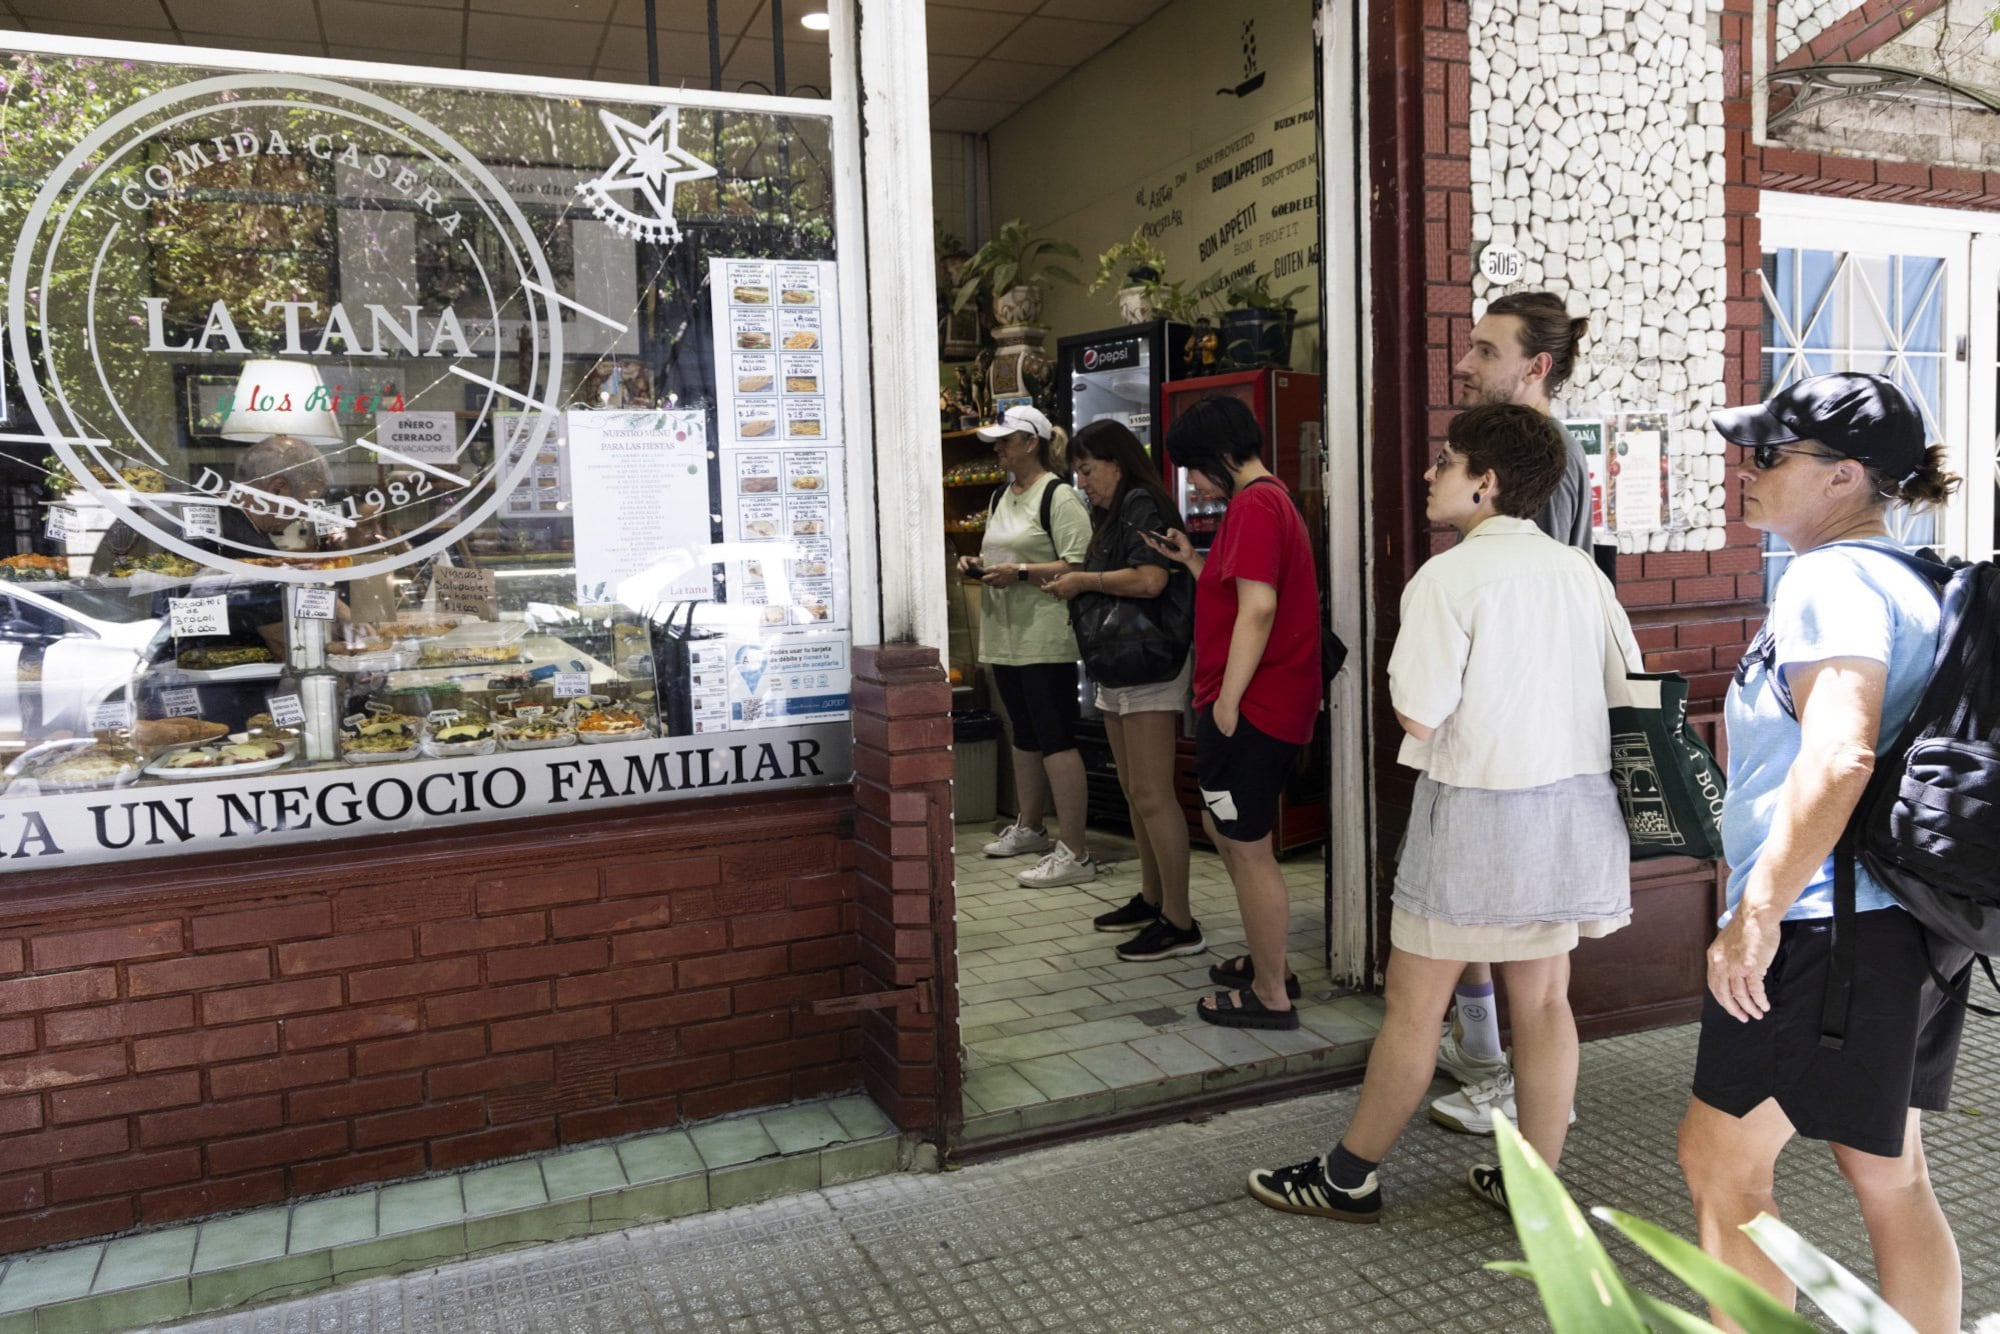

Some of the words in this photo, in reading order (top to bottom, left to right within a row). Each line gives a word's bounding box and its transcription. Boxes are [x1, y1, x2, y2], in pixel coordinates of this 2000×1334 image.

[1274, 115, 1296, 131] BUEN
[1196, 154, 1214, 173] BOM
[1214, 131, 1255, 163] PROVEITO
[121, 130, 290, 211] COMIDA
[308, 133, 463, 237] CASERA
[1212, 167, 1233, 193] BUON
[1235, 148, 1273, 182] APPETITO
[1262, 168, 1284, 187] ENJOY
[1285, 157, 1306, 175] YOUR
[1199, 232, 1219, 263] BON
[1259, 221, 1299, 247] PROFIT
[1273, 249, 1304, 279] GUTEN
[1488, 251, 1518, 277] 5015
[140, 297, 252, 354] LA
[264, 301, 478, 357] TANA
[1099, 347, 1128, 365] pepsi
[245, 384, 293, 412] los
[304, 384, 406, 413] Ricci's
[391, 433, 442, 442] CERRADO
[398, 420, 434, 429] ENERO
[602, 430, 643, 438] NUESTRO
[401, 445, 451, 453] VACACIONES
[601, 443, 624, 451] PARA
[625, 442, 640, 450] LAS
[642, 442, 675, 450] FIESTAS
[344, 470, 433, 520] 1982
[670, 586, 682, 595] La
[685, 586, 707, 595] tana
[0, 811, 64, 858] A
[88, 798, 195, 849] UN
[216, 767, 526, 838] NEGOCIO
[546, 738, 824, 804] FAMILIAR
